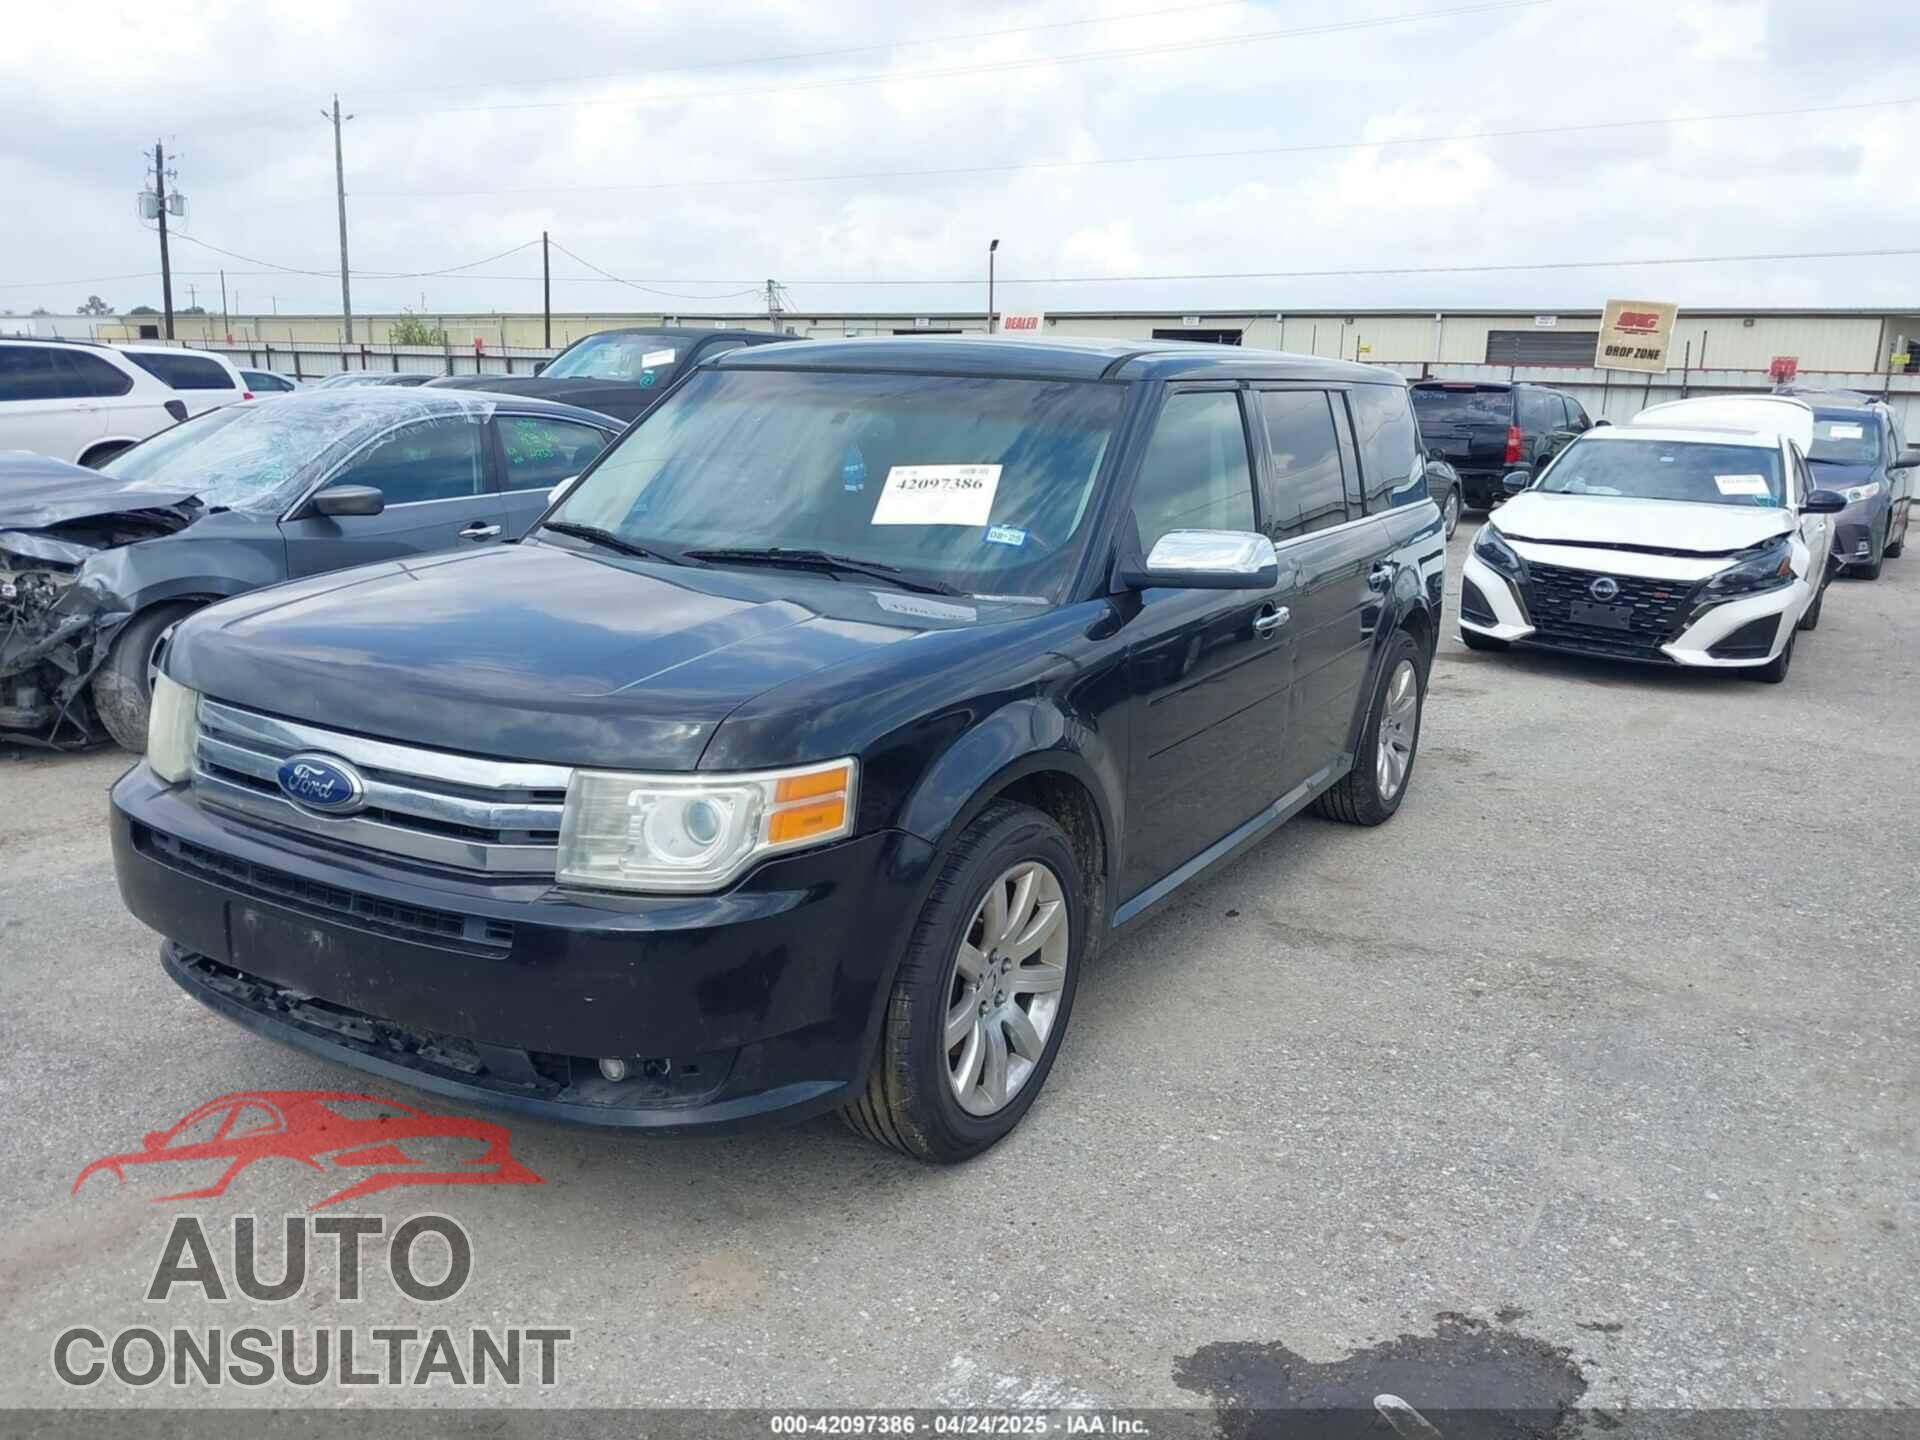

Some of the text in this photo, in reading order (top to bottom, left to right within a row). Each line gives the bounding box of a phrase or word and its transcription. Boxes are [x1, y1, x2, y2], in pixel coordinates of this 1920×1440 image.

[1005, 316, 1038, 329] DEALER
[1605, 345, 1661, 360] DROP ZONE
[896, 478, 983, 490] 42097386
[288, 764, 335, 798] Ford
